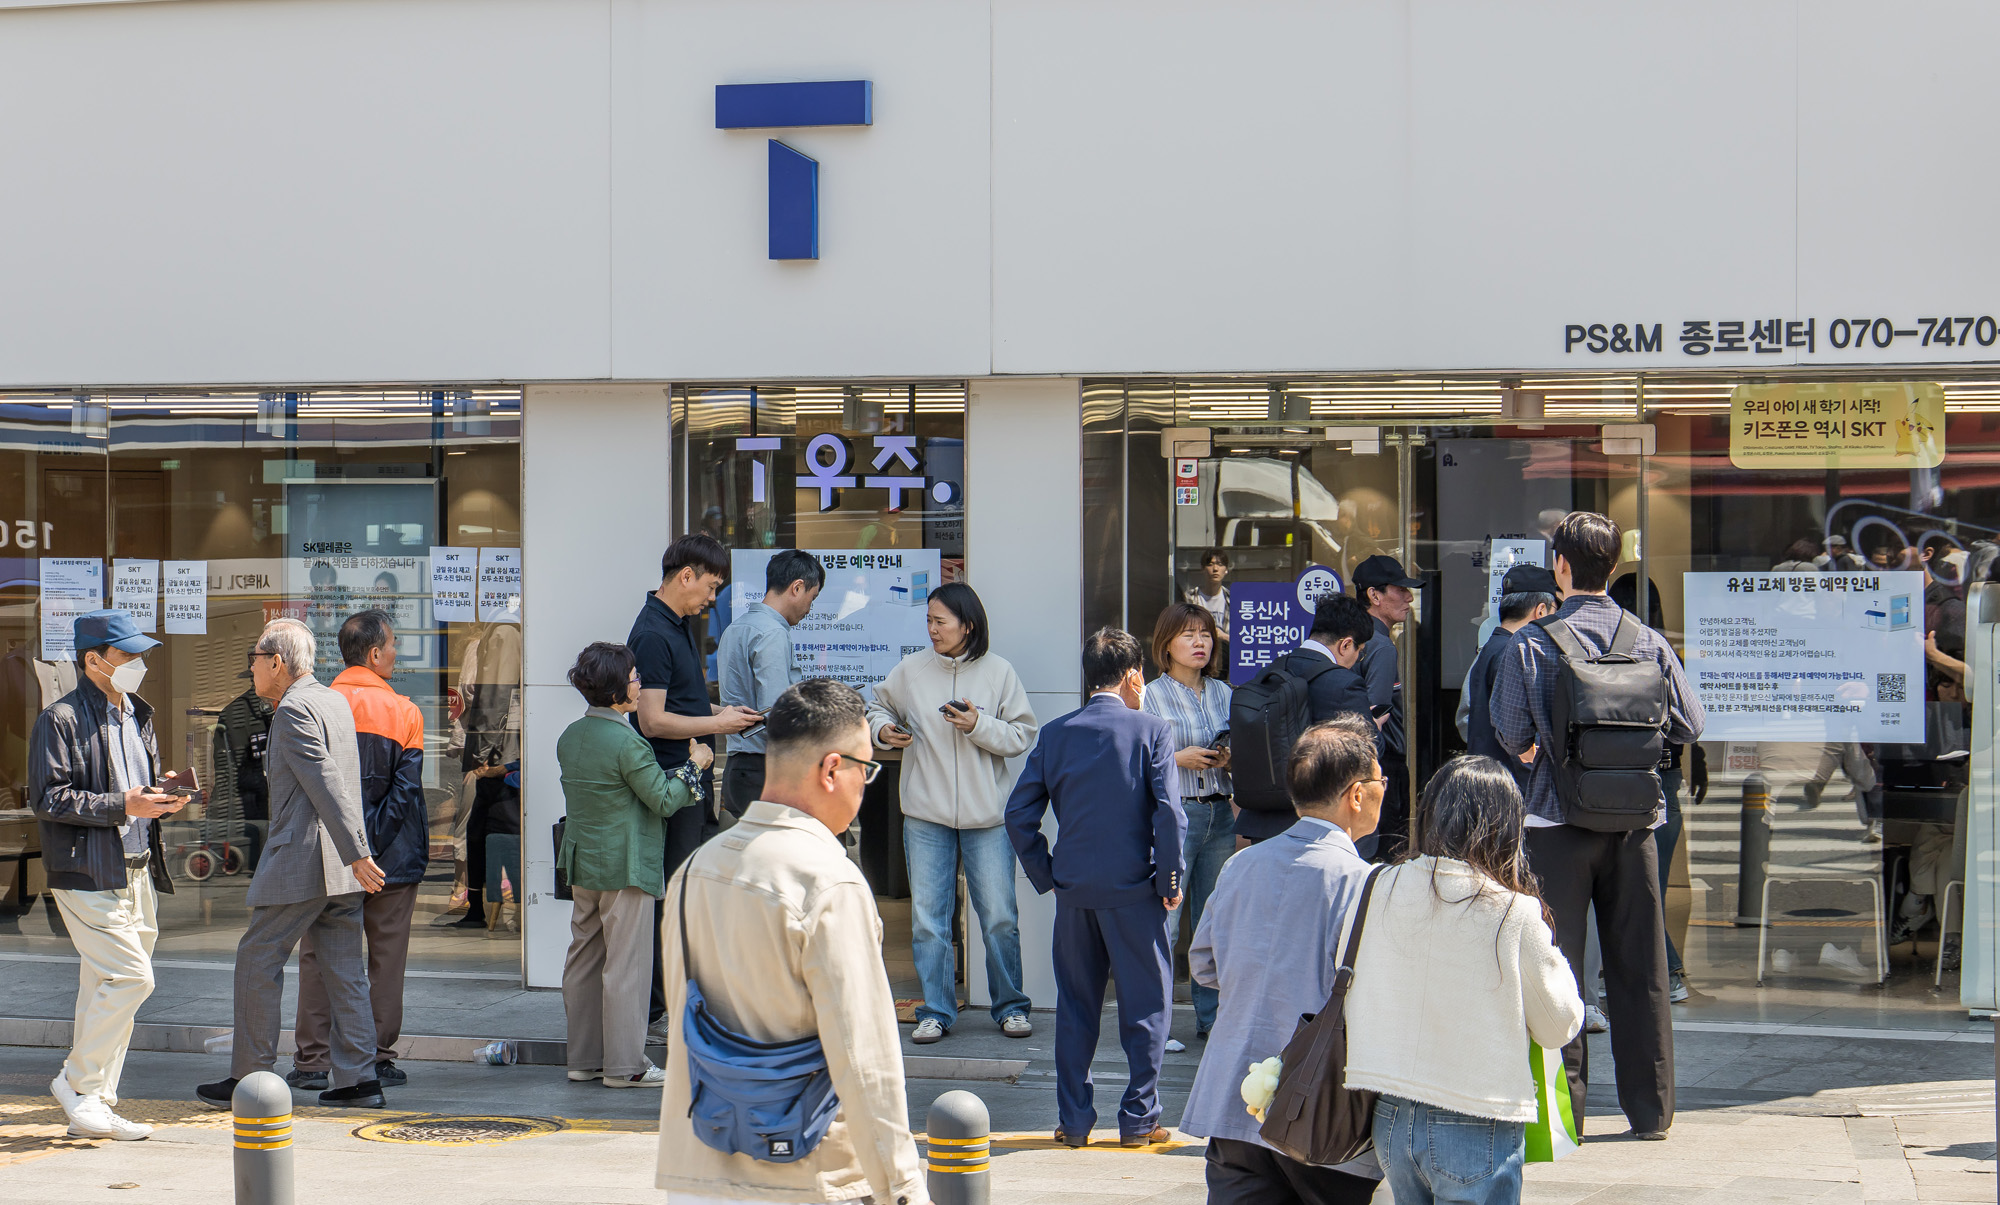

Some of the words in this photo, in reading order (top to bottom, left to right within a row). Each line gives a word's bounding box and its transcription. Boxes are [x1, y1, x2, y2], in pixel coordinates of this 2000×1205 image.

[715, 80, 873, 260] T
[1565, 323, 1663, 353] PS&M
[1679, 318, 1816, 356] 종로센터
[1829, 315, 2000, 349] 070-7470
[1743, 399, 1770, 415] 우리
[1773, 399, 1799, 415] 아이
[1803, 399, 1816, 415] 새
[1820, 399, 1846, 415] 학기
[1849, 399, 1881, 415] 시작!
[1743, 420, 1810, 439] 키즈폰은
[1814, 420, 1846, 439] 역시
[1850, 421, 1887, 437] SKT
[303, 542, 352, 553] SK텔레콤은
[303, 556, 330, 568] 끝까지
[332, 556, 359, 568] 책임을
[361, 556, 416, 568] 다하겠습니다
[823, 554, 848, 569] 방문
[850, 554, 874, 569] 예약
[877, 554, 902, 569] 안내
[1304, 577, 1334, 590] 모두의
[1727, 577, 1754, 592] 유심
[1758, 577, 1786, 592] 교체
[1788, 577, 1816, 592] 방문
[1820, 577, 1848, 592] 예약
[1851, 577, 1880, 592] 안내
[1239, 601, 1290, 620] 통신사
[1239, 625, 1305, 644] 상관없이
[1700, 639, 1713, 647] 이미
[1714, 639, 1728, 647] 유심
[1729, 639, 1749, 647] 교체를
[1750, 639, 1778, 647] 예약하신
[1778, 639, 1806, 647] 고객님이
[1238, 650, 1272, 668] 모두
[1700, 650, 1713, 658] 많이
[1736, 650, 1763, 658] 즉각적인
[1764, 650, 1777, 658] 유심
[1778, 650, 1799, 658] 교체가
[1800, 650, 1836, 658] 어렵습니다.
